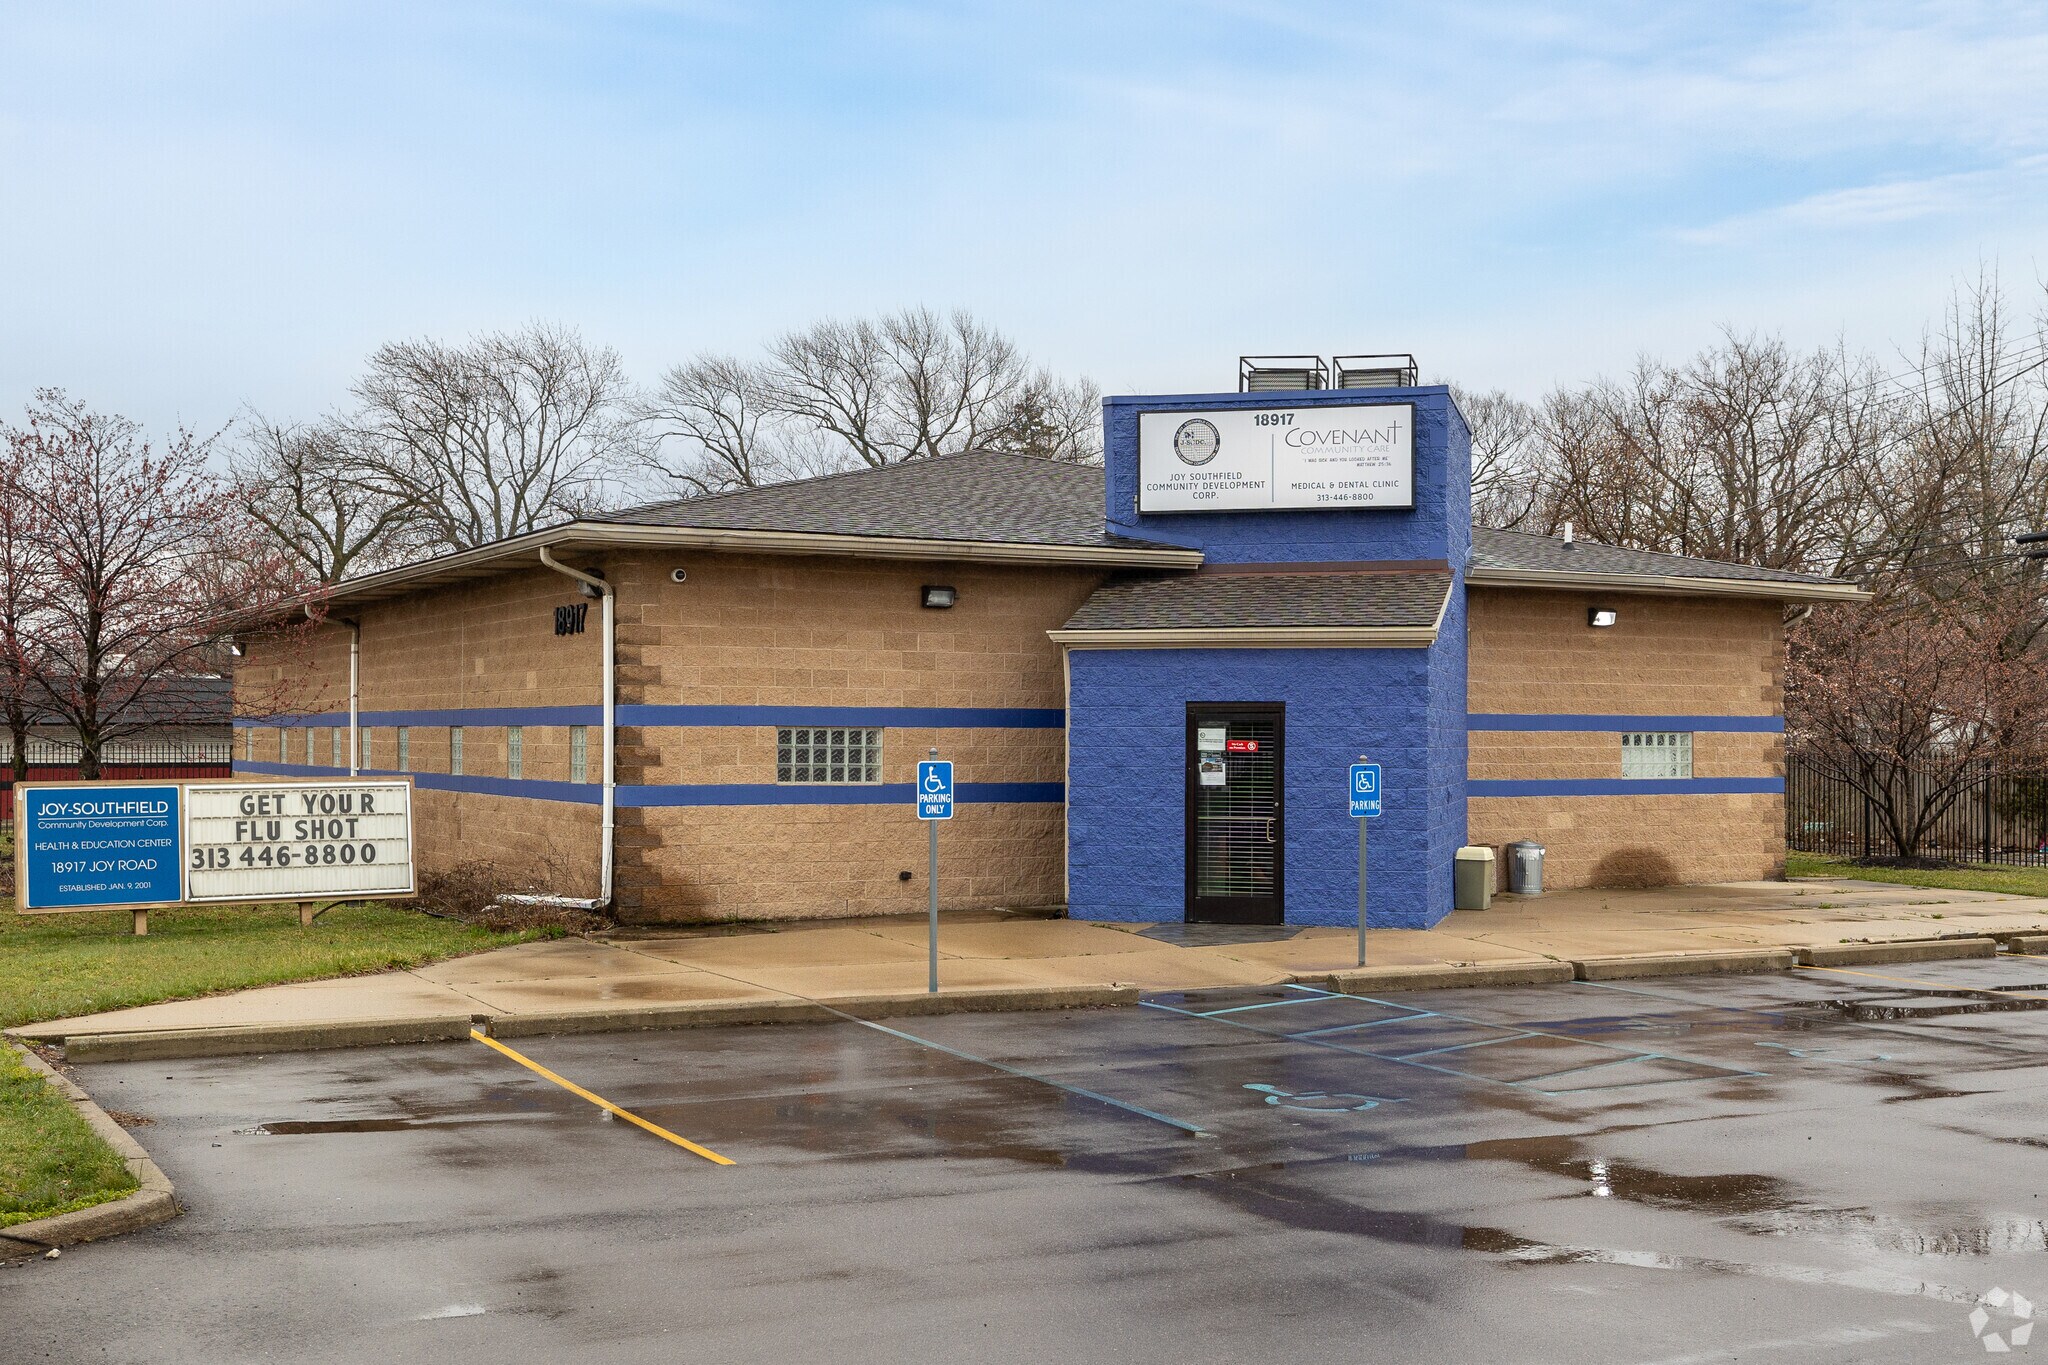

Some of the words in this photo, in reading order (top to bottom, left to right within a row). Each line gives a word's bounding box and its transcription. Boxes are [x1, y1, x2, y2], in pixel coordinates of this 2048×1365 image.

[1254, 413, 1295, 427] 18917
[1285, 420, 1402, 448] COVENANT
[1300, 445, 1366, 455] COMMUNITY
[1367, 444, 1391, 453] CARE
[1169, 473, 1186, 481] JOY
[1189, 472, 1242, 481] SOUTHFIELD
[1146, 482, 1199, 491] COMMUNITY
[1202, 481, 1265, 490] DEVELOPMENT
[1291, 482, 1326, 490] MEDICAL
[1339, 481, 1369, 489] DENTAL
[1372, 480, 1399, 488] CLINIC
[1192, 491, 1219, 500] CORP.
[1316, 493, 1374, 501] 313-446-8800
[554, 603, 588, 636] 18917
[920, 793, 951, 803] PARKING
[38, 801, 168, 816] JOY-SOUTHFIELD
[240, 794, 285, 816] GET
[926, 804, 945, 814] ONLY
[1351, 800, 1380, 810] PARKING
[38, 821, 87, 830] Community
[89, 820, 145, 829] Development
[146, 819, 169, 828] Corp.
[236, 820, 281, 842] FLU
[294, 818, 359, 840] SHOT
[35, 842, 70, 850] HEALTH
[72, 841, 80, 850] &
[81, 840, 136, 850] EDUCATION
[137, 838, 172, 848] CENTER
[192, 848, 231, 869] 313
[239, 843, 376, 867] 446-8800
[52, 861, 87, 874] 18917
[89, 860, 115, 872] JOY
[118, 859, 158, 871] ROAD
[59, 883, 107, 892] ESTABLISHED
[108, 882, 126, 890] JAN.
[134, 882, 152, 890] 2001
